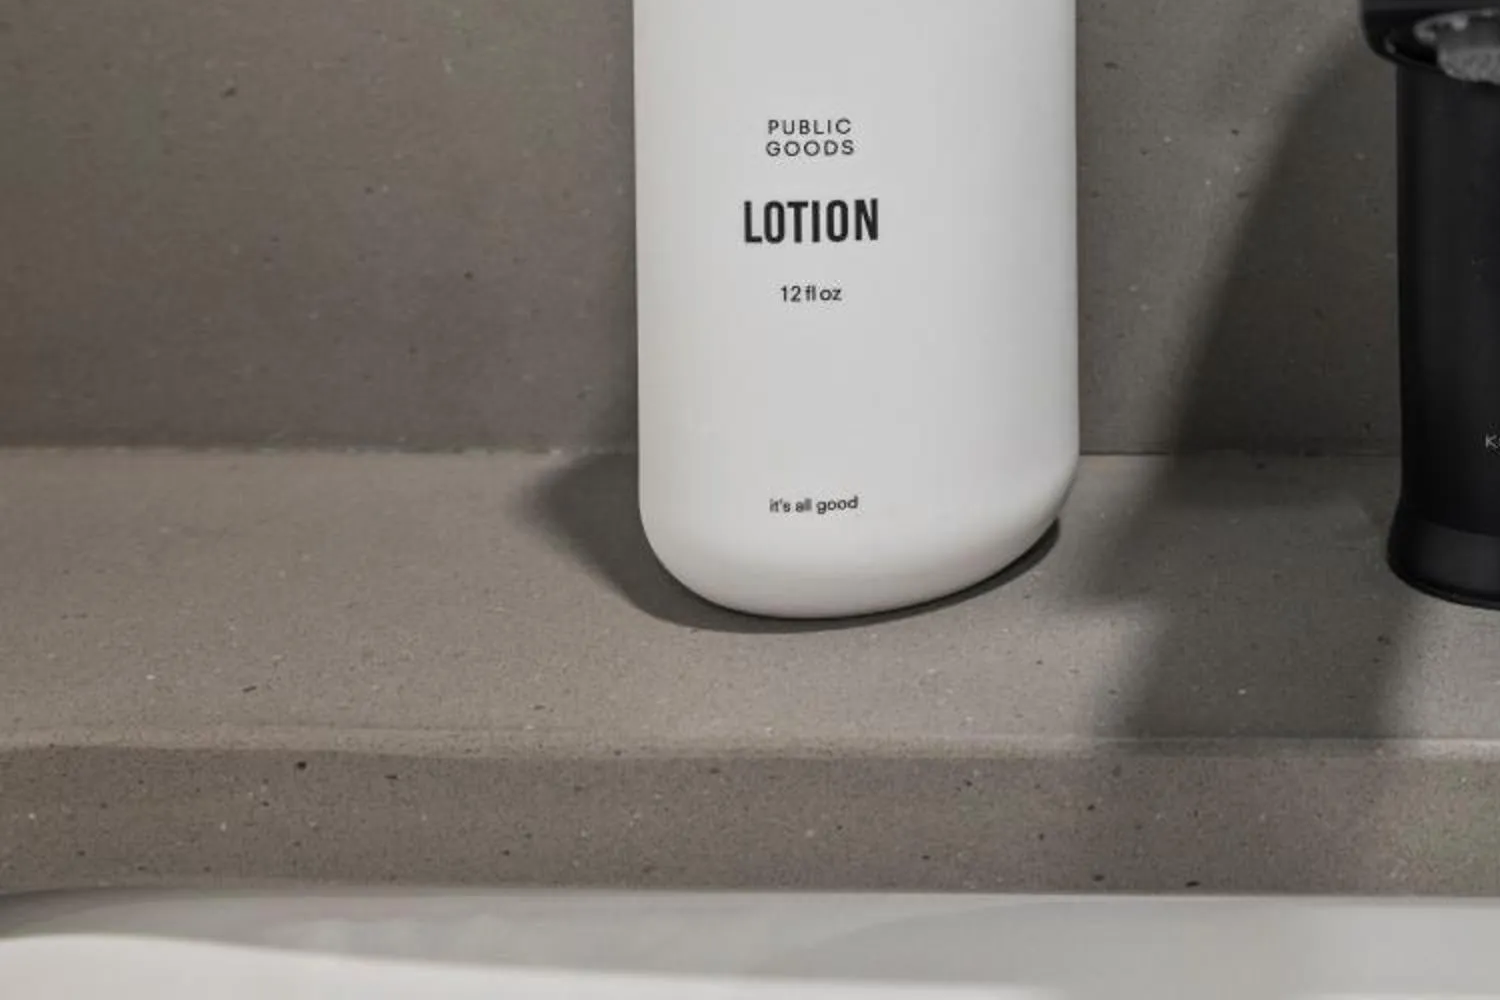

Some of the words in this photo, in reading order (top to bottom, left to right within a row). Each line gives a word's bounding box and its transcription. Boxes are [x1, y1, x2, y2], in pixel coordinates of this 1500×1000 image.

[767, 117, 852, 136] PUBLIC
[765, 139, 855, 158] GOODS
[743, 197, 879, 245] LOTION
[780, 285, 802, 303] 12
[769, 498, 792, 513] it's
[794, 497, 813, 513] all
[815, 495, 859, 515] good
